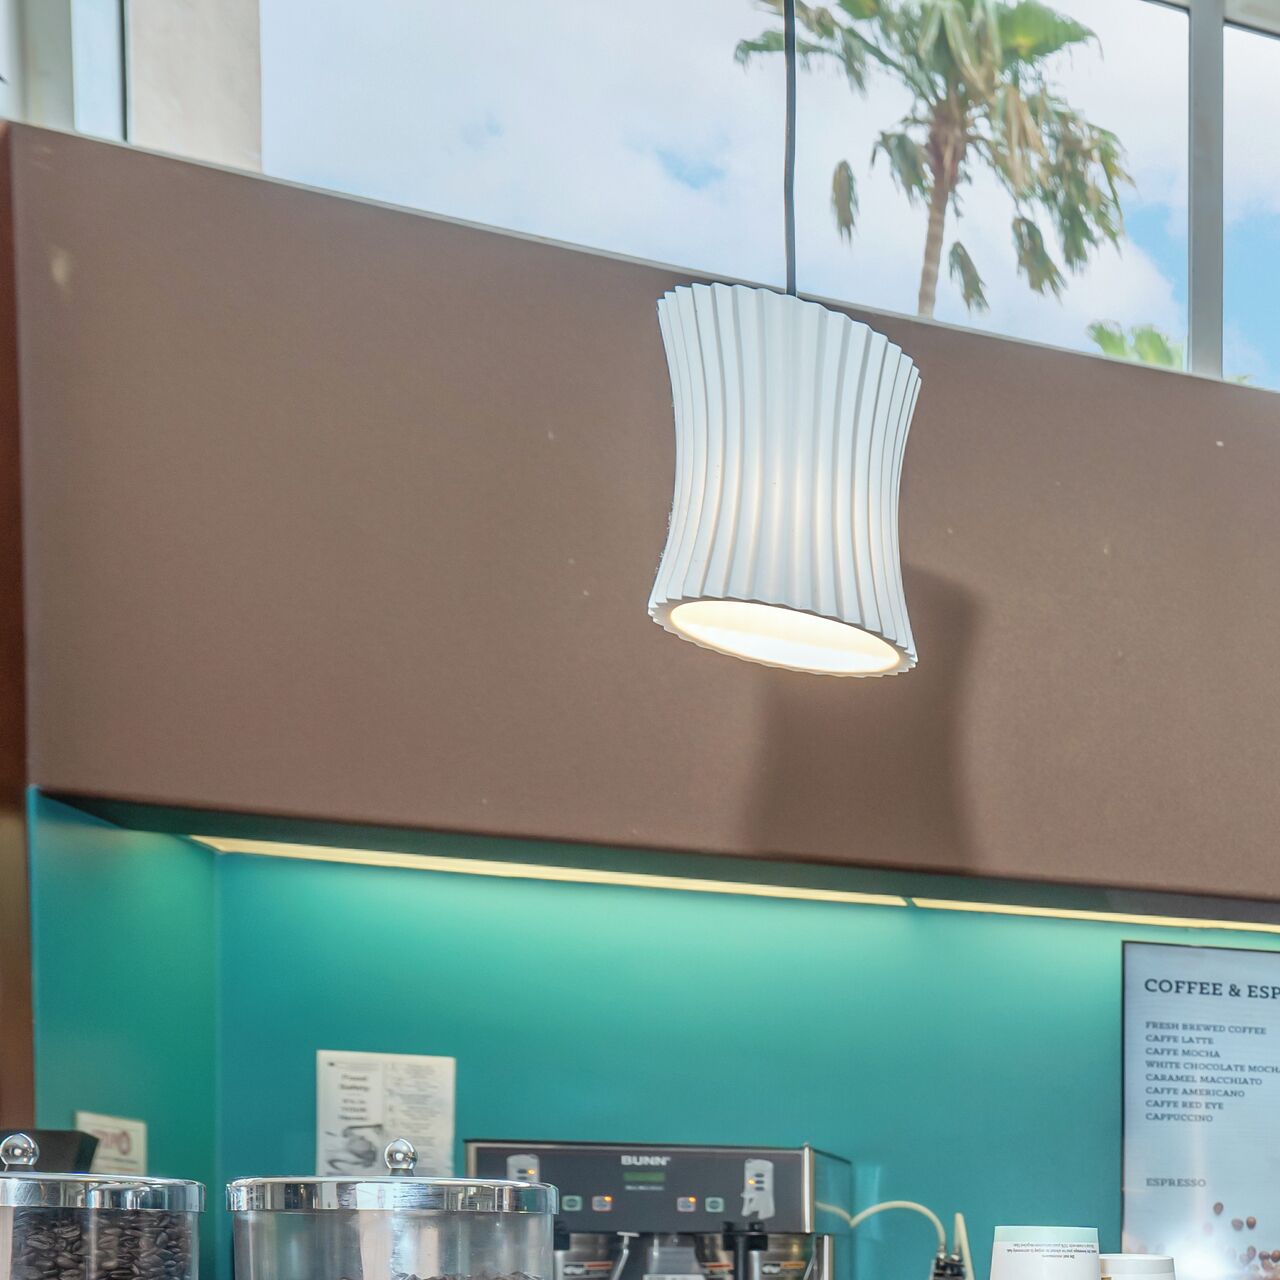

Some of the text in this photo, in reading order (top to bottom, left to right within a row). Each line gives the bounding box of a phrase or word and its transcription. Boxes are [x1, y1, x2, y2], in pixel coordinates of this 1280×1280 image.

[1145, 979, 1223, 996] COFFEE
[1228, 984, 1241, 997] &
[1145, 1021, 1267, 1035] FRESH BREWED COFFEE
[1145, 1035, 1214, 1045] CAFFE LATTE
[1145, 1048, 1221, 1058] CAFFE MOCHA
[1145, 1061, 1181, 1069] WHITE
[1183, 1062, 1246, 1072] CHOCOLATE
[1145, 1074, 1263, 1086] CARAMEL MACCHIATO
[1145, 1087, 1245, 1098] CAFFE AMERICANO
[1145, 1100, 1224, 1110] CAFFE RED EYE
[1145, 1113, 1214, 1122] CAPPUCCINO
[1146, 1178, 1207, 1188] ESPRESSO
